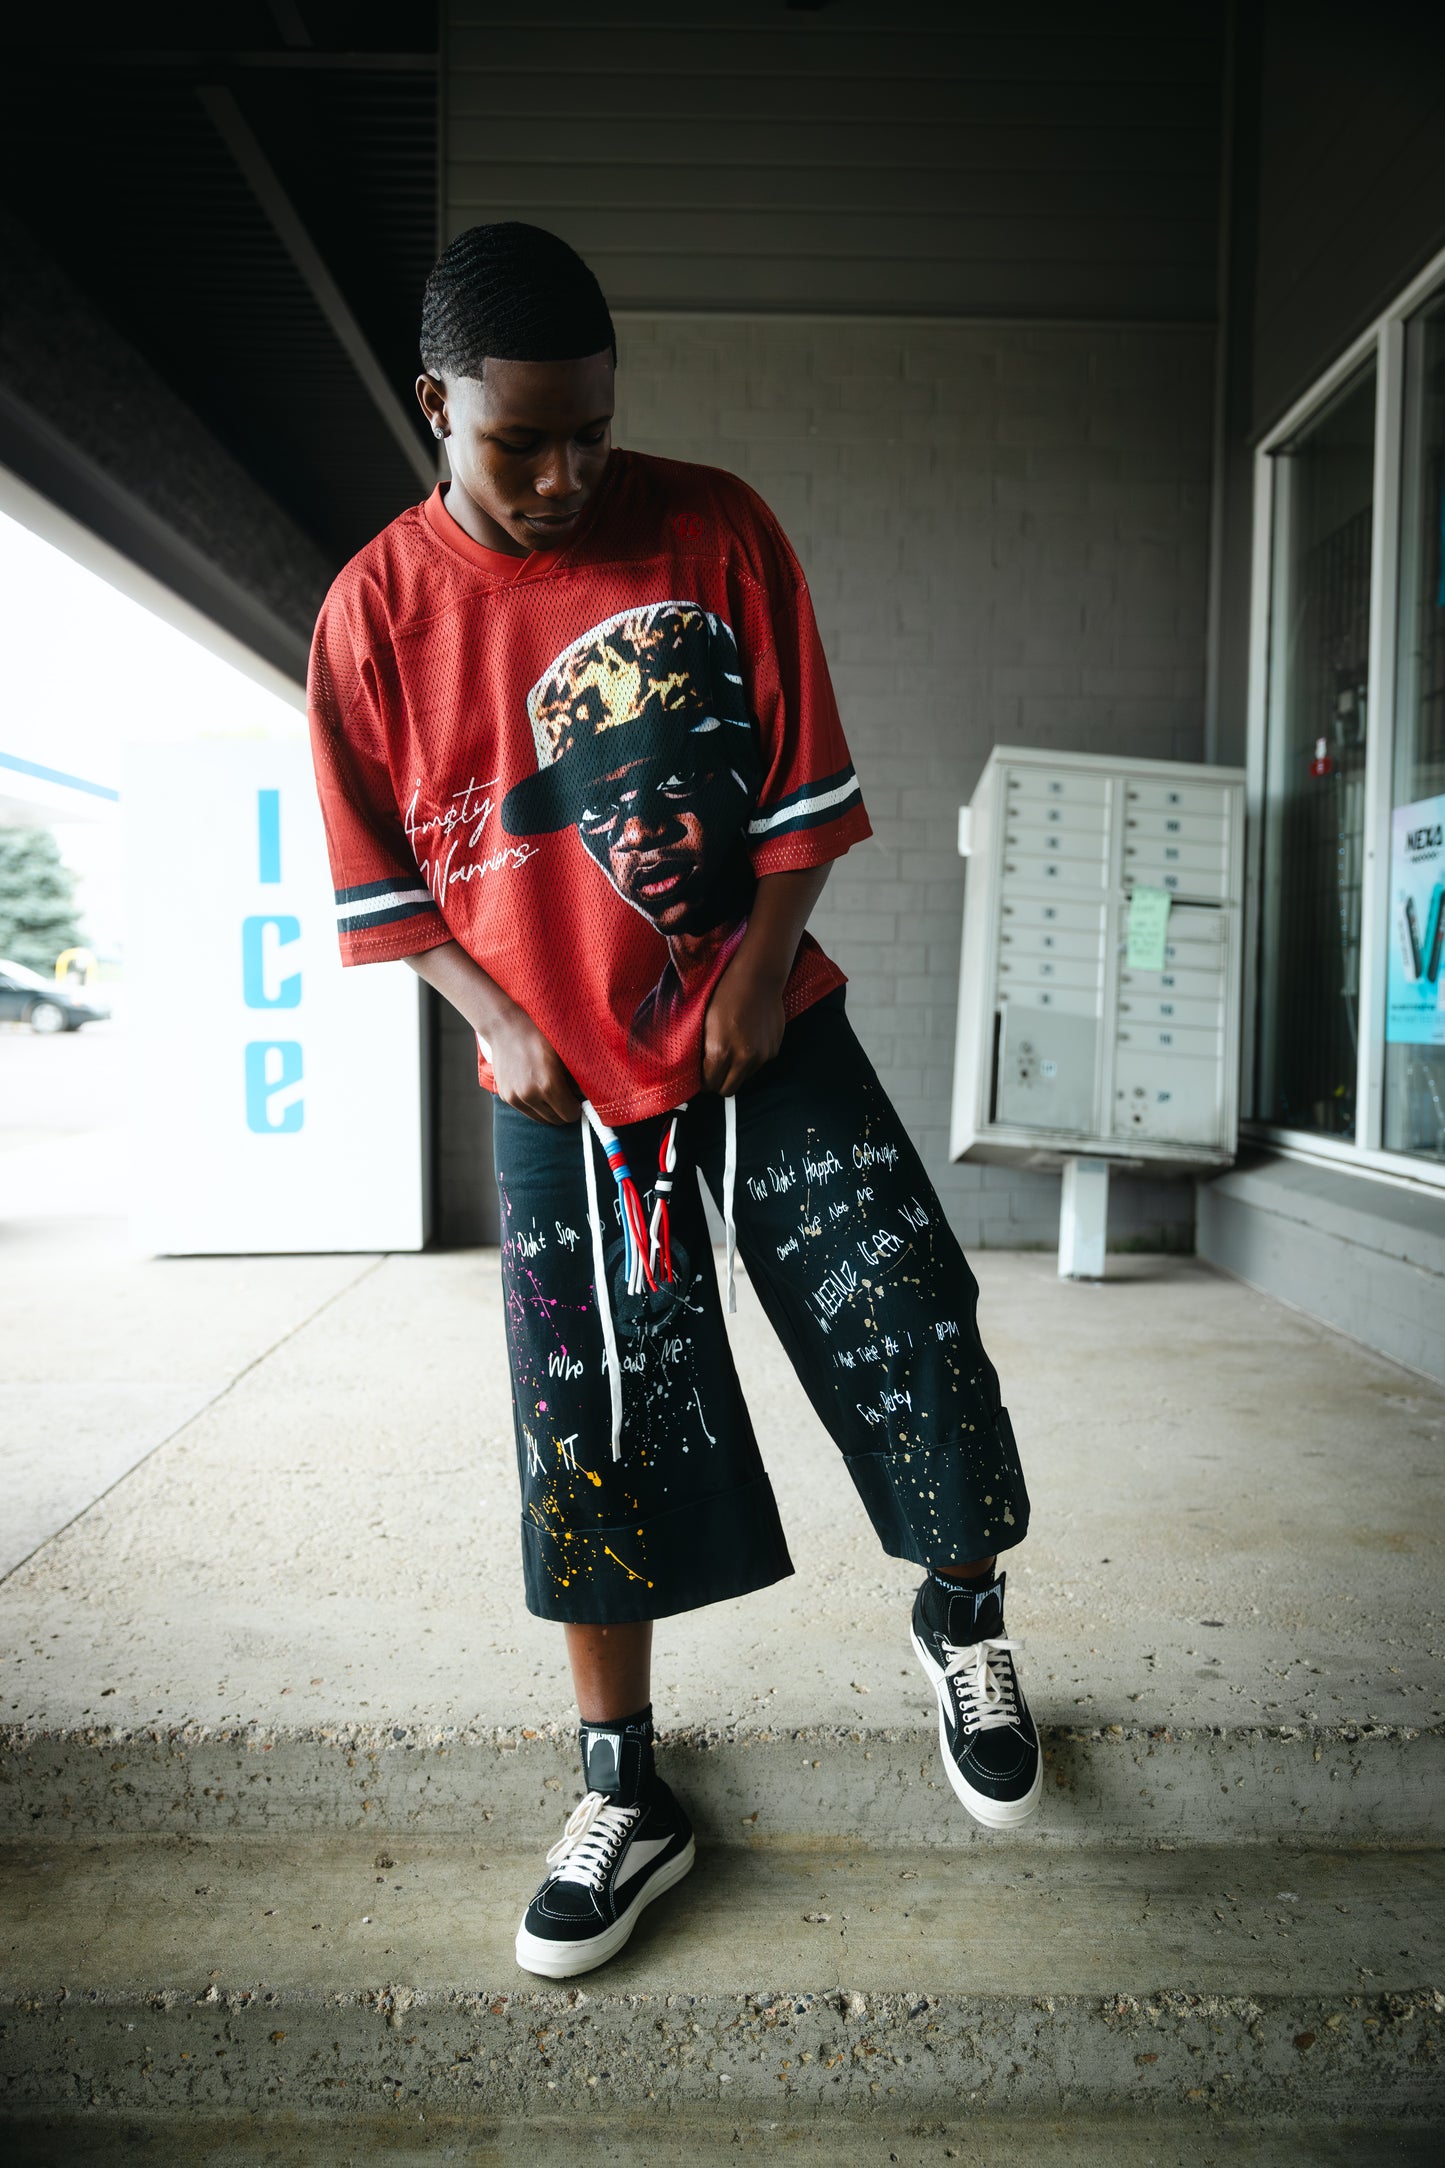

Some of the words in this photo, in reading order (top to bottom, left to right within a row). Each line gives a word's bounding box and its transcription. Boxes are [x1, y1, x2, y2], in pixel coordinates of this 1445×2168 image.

[828, 1201, 849, 1221] Not
[516, 1216, 547, 1258] Didn't
[555, 1220, 581, 1252] Sign
[547, 1351, 584, 1381] Who
